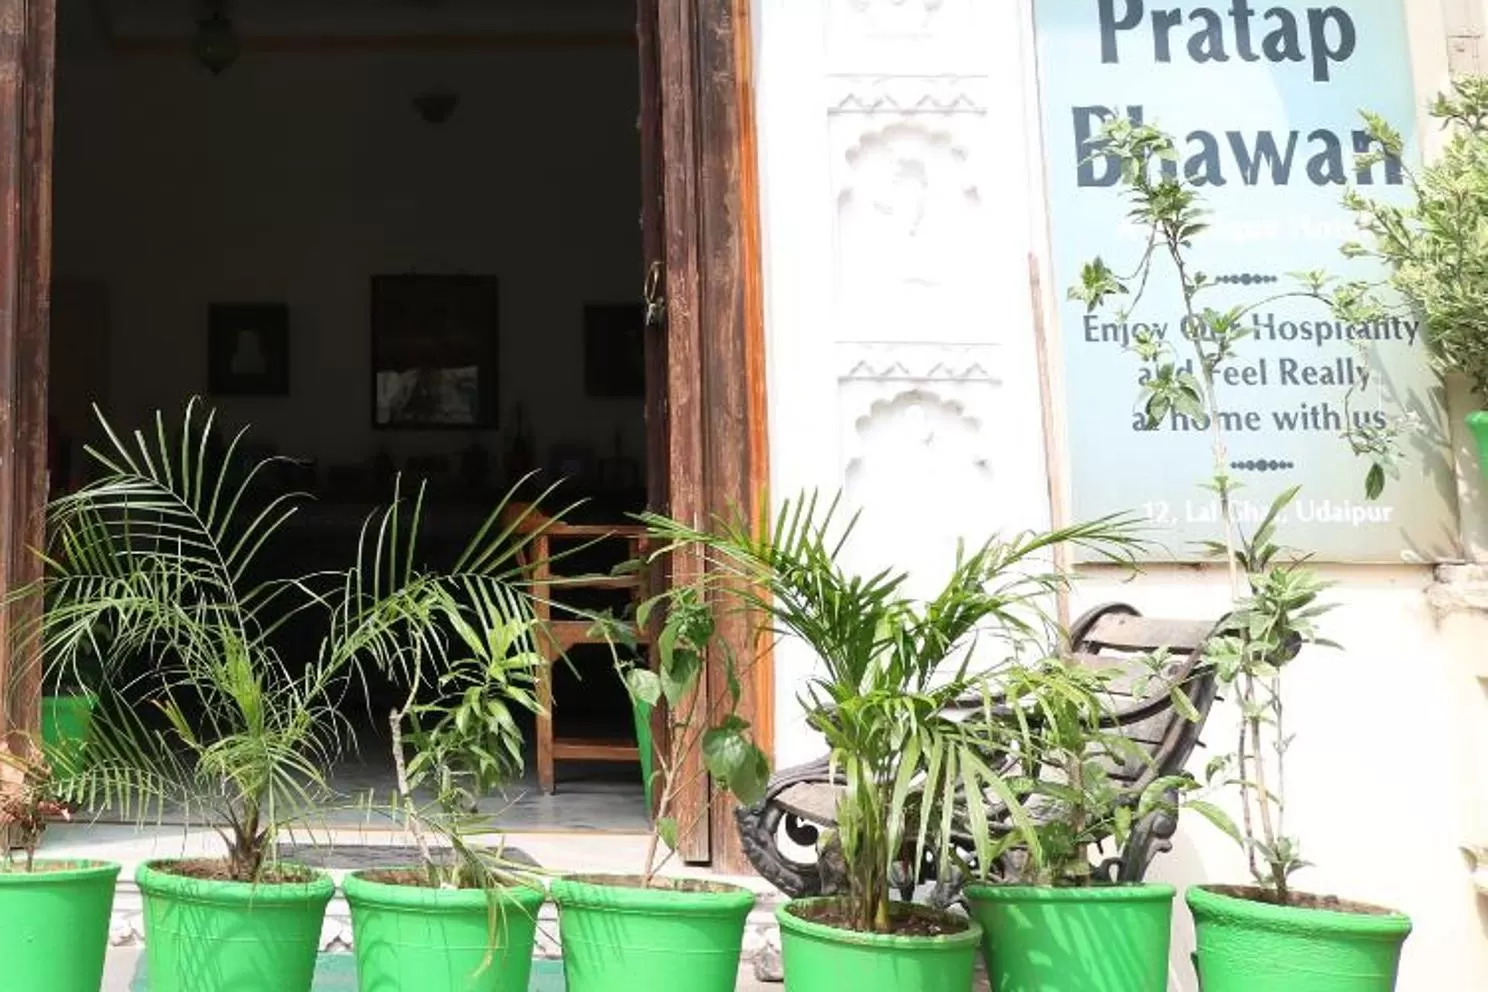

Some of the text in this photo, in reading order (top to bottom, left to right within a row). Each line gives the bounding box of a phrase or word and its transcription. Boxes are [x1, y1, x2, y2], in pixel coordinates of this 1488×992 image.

[1071, 104, 1404, 188] Bhawan
[1083, 314, 1168, 349] Enjoy
[1279, 357, 1370, 392] Really
[1170, 406, 1262, 432] home
[1272, 402, 1342, 432] with
[1352, 410, 1387, 431] us
[1186, 499, 1217, 523] Lal
[1296, 499, 1395, 527] Udaipur
